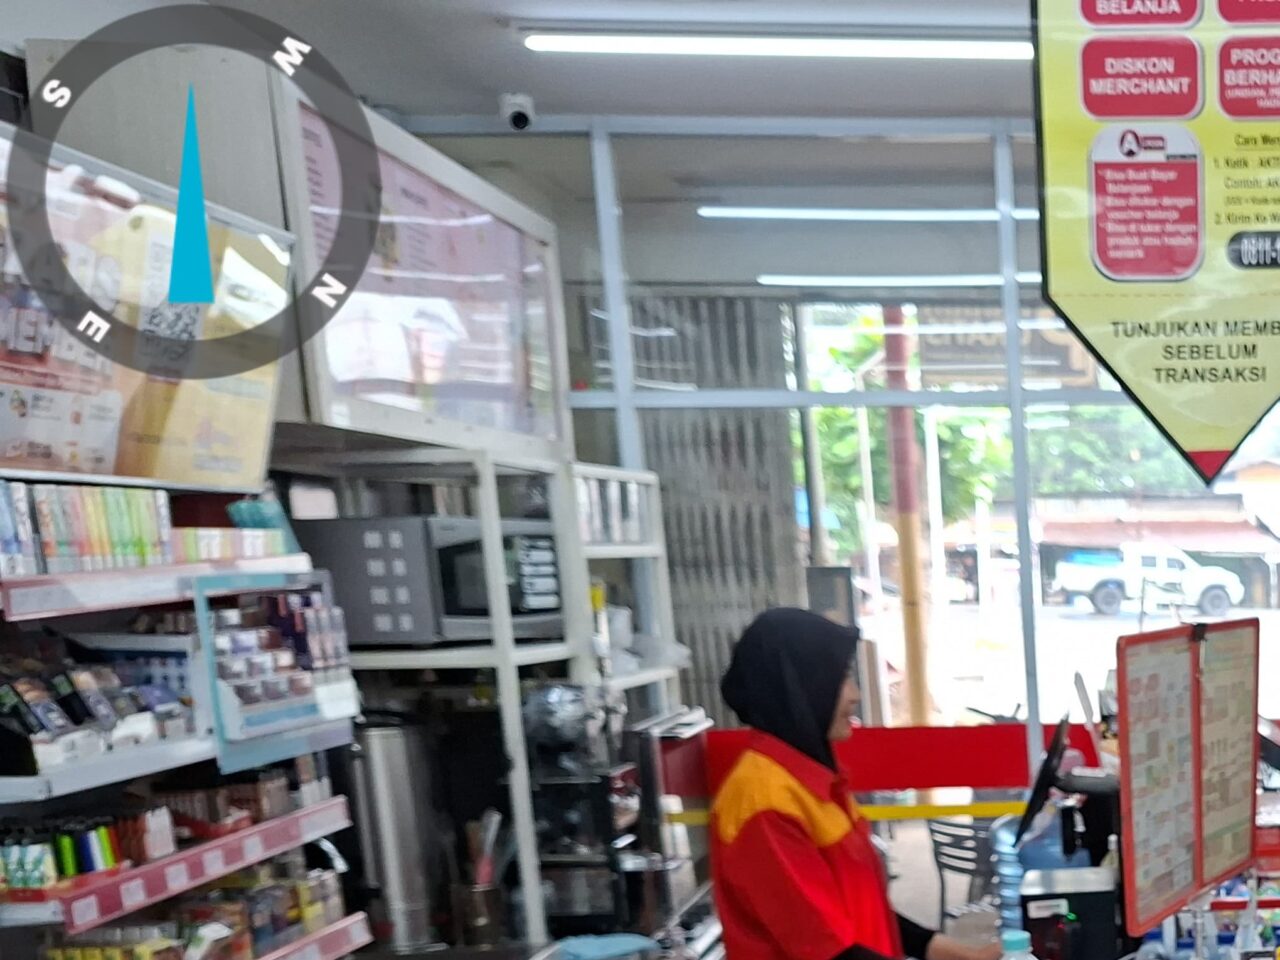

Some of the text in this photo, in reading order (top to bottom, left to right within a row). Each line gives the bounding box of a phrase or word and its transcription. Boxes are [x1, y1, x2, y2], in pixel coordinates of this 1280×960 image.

[1096, 0, 1182, 15] BELANJA
[1104, 57, 1175, 75] DISKON
[1089, 77, 1191, 95] MERCHANT
[1111, 321, 1217, 338] TUNJUKAN
[1163, 344, 1258, 360] SEBELUM
[1154, 366, 1267, 384] TRANSAKSI
